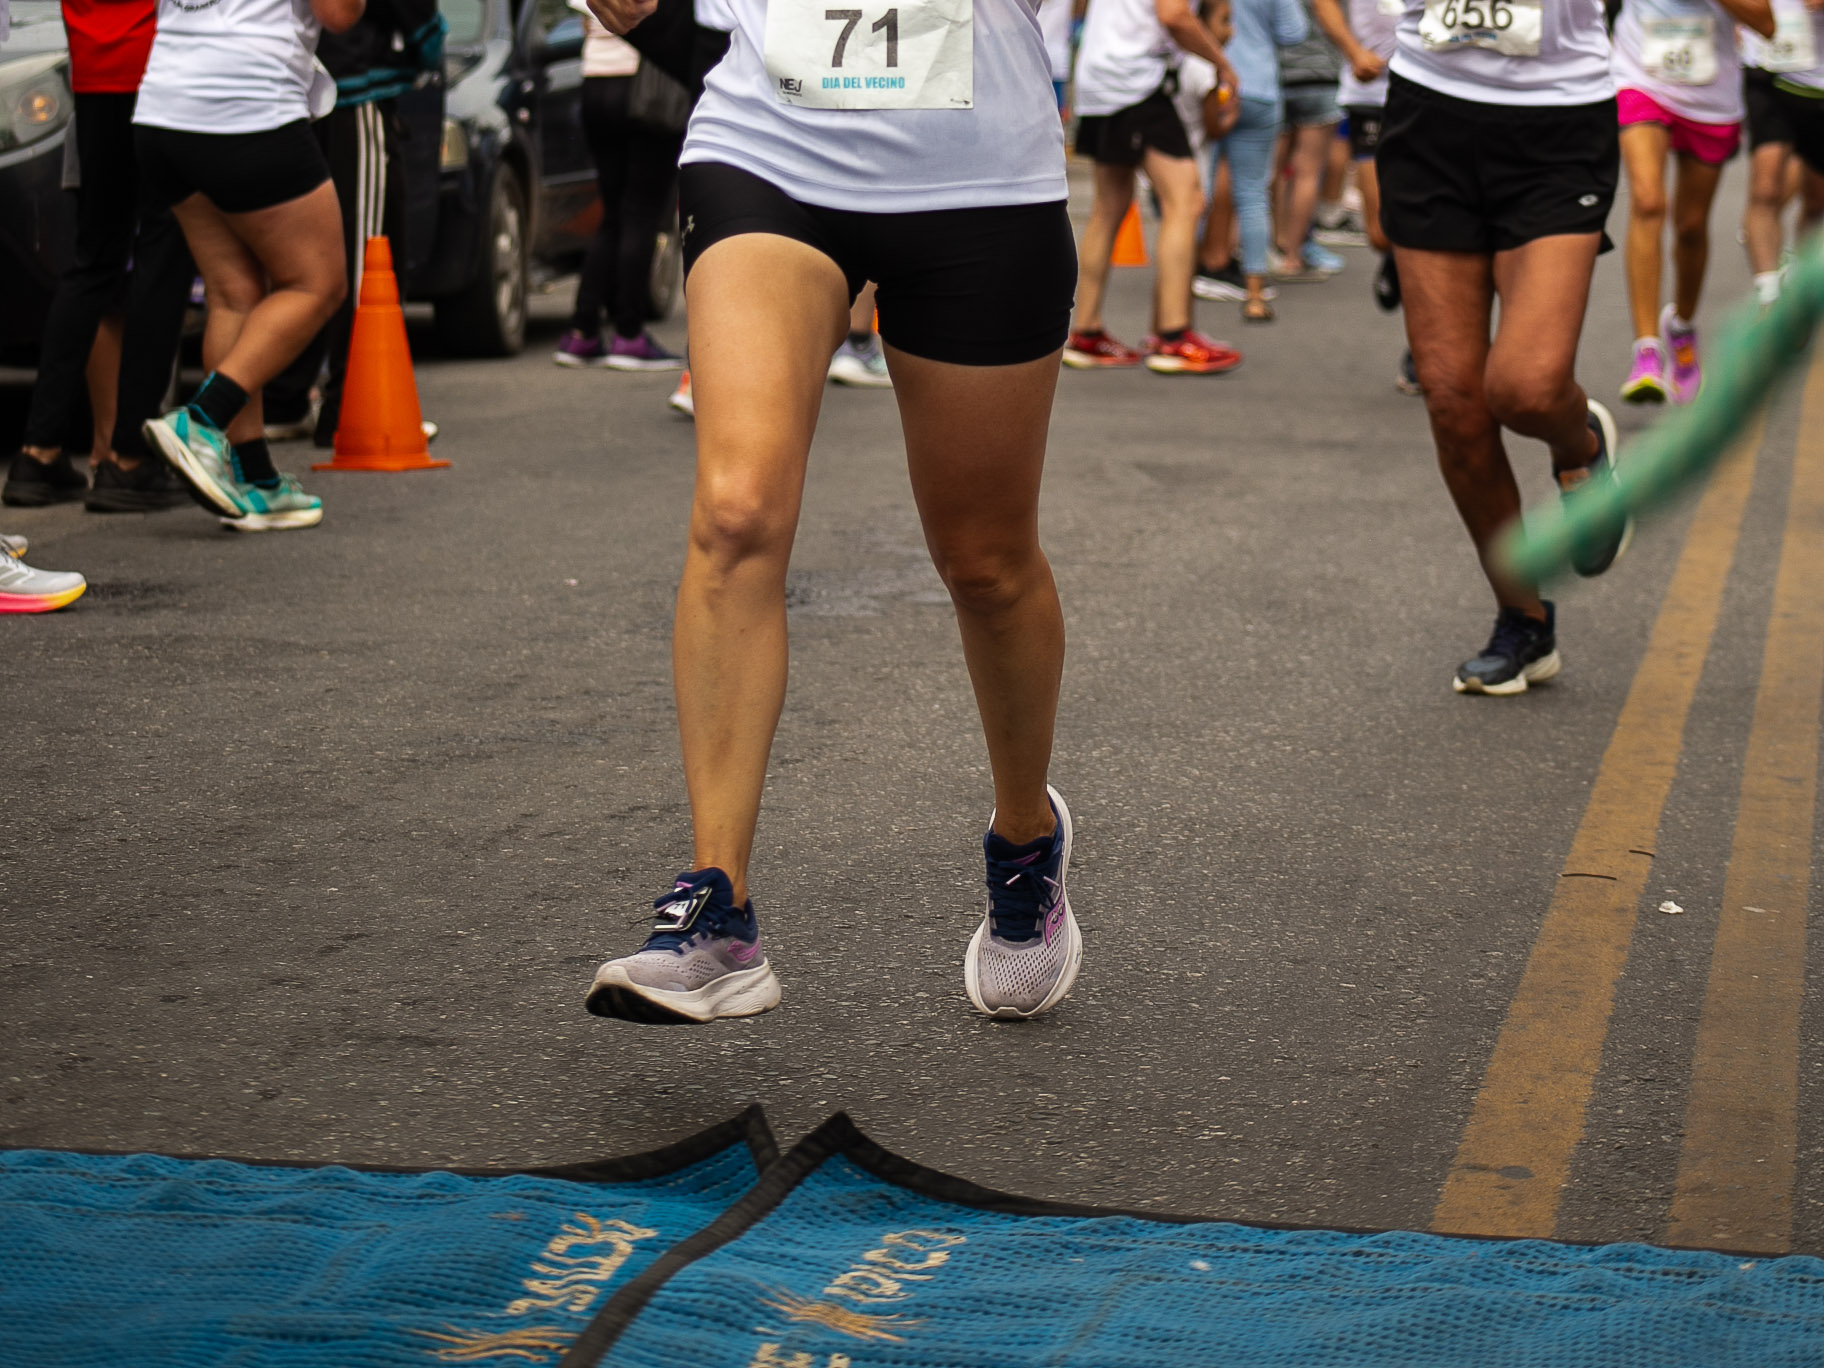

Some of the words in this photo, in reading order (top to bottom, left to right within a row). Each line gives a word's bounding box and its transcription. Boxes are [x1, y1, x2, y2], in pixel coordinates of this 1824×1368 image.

[825, 8, 898, 68] 71
[822, 77, 841, 89] DIA
[843, 77, 862, 89] DEL
[864, 76, 905, 89] VECINO
